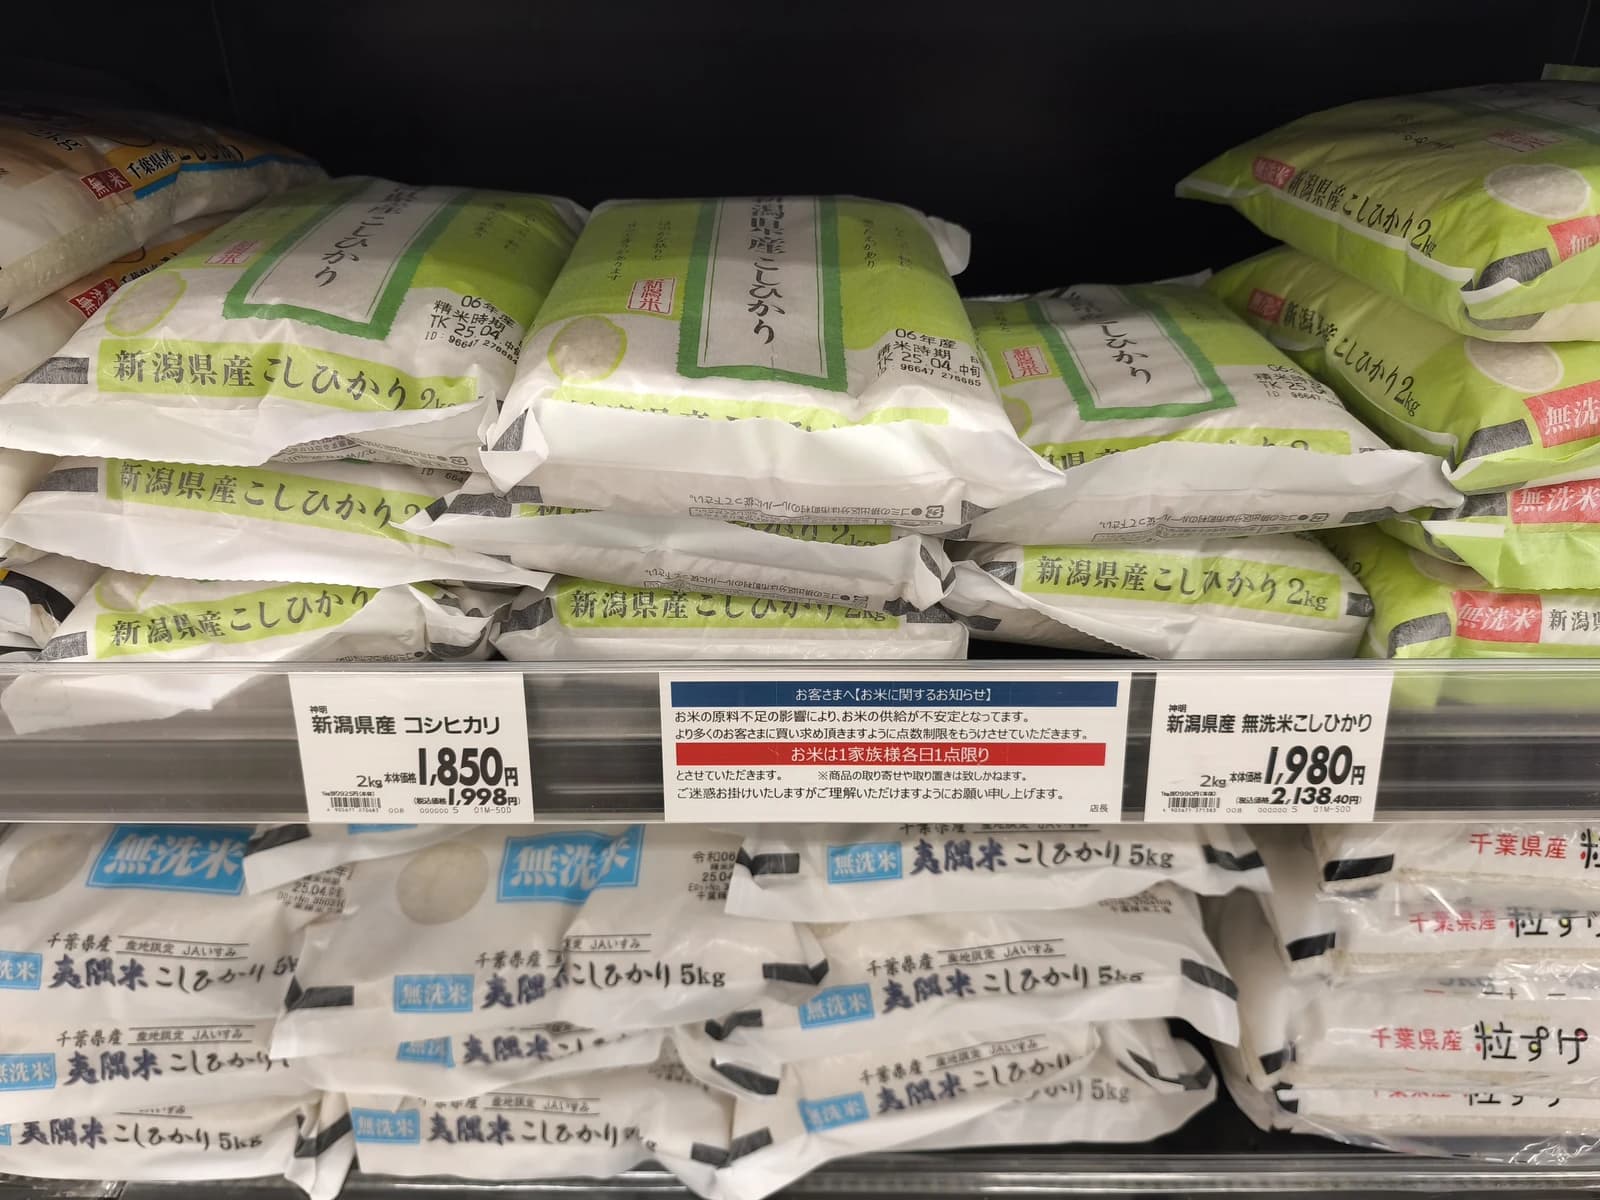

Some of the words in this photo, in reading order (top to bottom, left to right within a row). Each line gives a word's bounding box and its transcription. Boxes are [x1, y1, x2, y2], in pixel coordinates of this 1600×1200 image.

[126, 148, 178, 179] 千葉県産
[900, 362, 935, 376] 96647
[1515, 484, 1600, 513] 無洗米
[1036, 554, 1329, 612] 新潟県産こしひかり2kg
[1456, 602, 1537, 632] 無洗米
[795, 687, 992, 702] お客さまへ【お米に関するお知らせ】
[312, 714, 397, 735] 新潟県産
[403, 716, 500, 735] コシヒカリ
[674, 710, 1030, 724] お米の原料不足の影響により、お米の供給が不安定となってます。
[1166, 714, 1236, 734] 新潟県産
[1241, 713, 1373, 734] 無洗米こしひかり
[675, 727, 1089, 741] より多くのお客さまに買い求め頂きますように点数制限をもうけさせていただきます。
[791, 746, 991, 763] お米は1家族様各日1点限り
[356, 775, 383, 789] 2kg
[675, 769, 784, 782] とさせていただきます。
[1199, 774, 1227, 788] 2kg
[676, 786, 1065, 801] ご迷惑お掛けいたしますがご理解いただけますようにお願い申し上げます。
[1089, 803, 1109, 814] 店長
[103, 832, 246, 879] 無洗米
[1469, 832, 1568, 860] 千葉県産
[509, 836, 632, 891] 無洗米
[833, 850, 898, 875] 無洗米
[1408, 909, 1497, 933] 千葉県産
[47, 932, 113, 953] 千葉県産
[474, 948, 542, 970] 千葉県産
[867, 952, 934, 977] 千葉県産
[400, 983, 468, 1006] 無洗米
[805, 993, 870, 1022] 無洗米
[56, 1028, 123, 1048] 千葉県産
[1370, 1026, 1463, 1052] 千葉県産
[859, 1058, 923, 1085] 千葉県産
[355, 1114, 415, 1137] 無洗米
